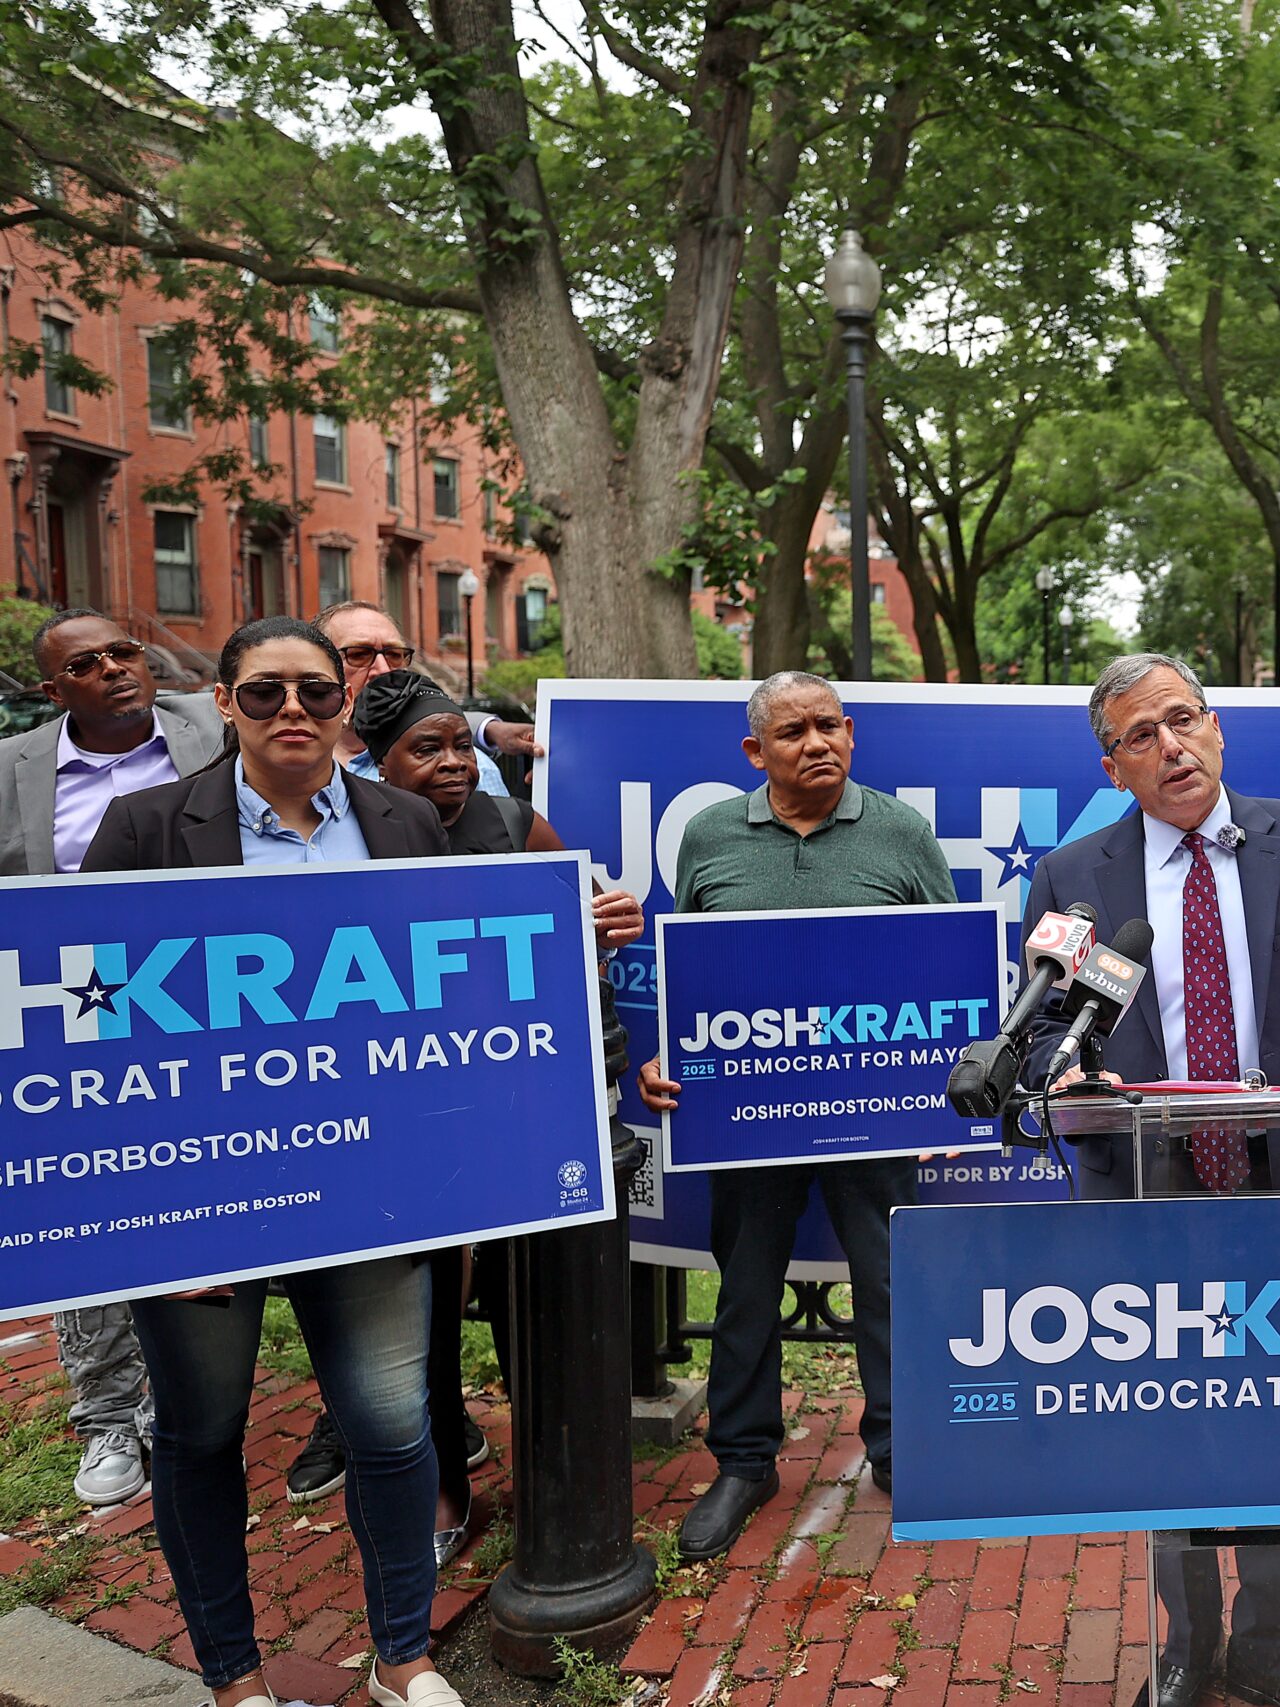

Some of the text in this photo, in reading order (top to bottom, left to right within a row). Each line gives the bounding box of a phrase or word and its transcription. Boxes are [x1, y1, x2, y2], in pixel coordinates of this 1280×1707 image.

[1061, 923, 1088, 952] WCVB
[1084, 967, 1128, 997] wbur
[1101, 955, 1132, 980] 90.9
[0, 1022, 558, 1115] CRAT FOR MAYOR
[682, 1047, 968, 1077] 2025 DEMOCRAT FOR MAY
[730, 1093, 946, 1122] JOSHFORBOSTON.COM
[0, 1117, 370, 1188] HFORBOSTON.COM
[918, 1164, 1073, 1183] ID FOR BY JOSH
[560, 1187, 588, 1199] 3-68
[0, 1190, 321, 1249] AID FOR BY JOSH KRAFT FOR BOSTON
[953, 1392, 1016, 1413] 2025
